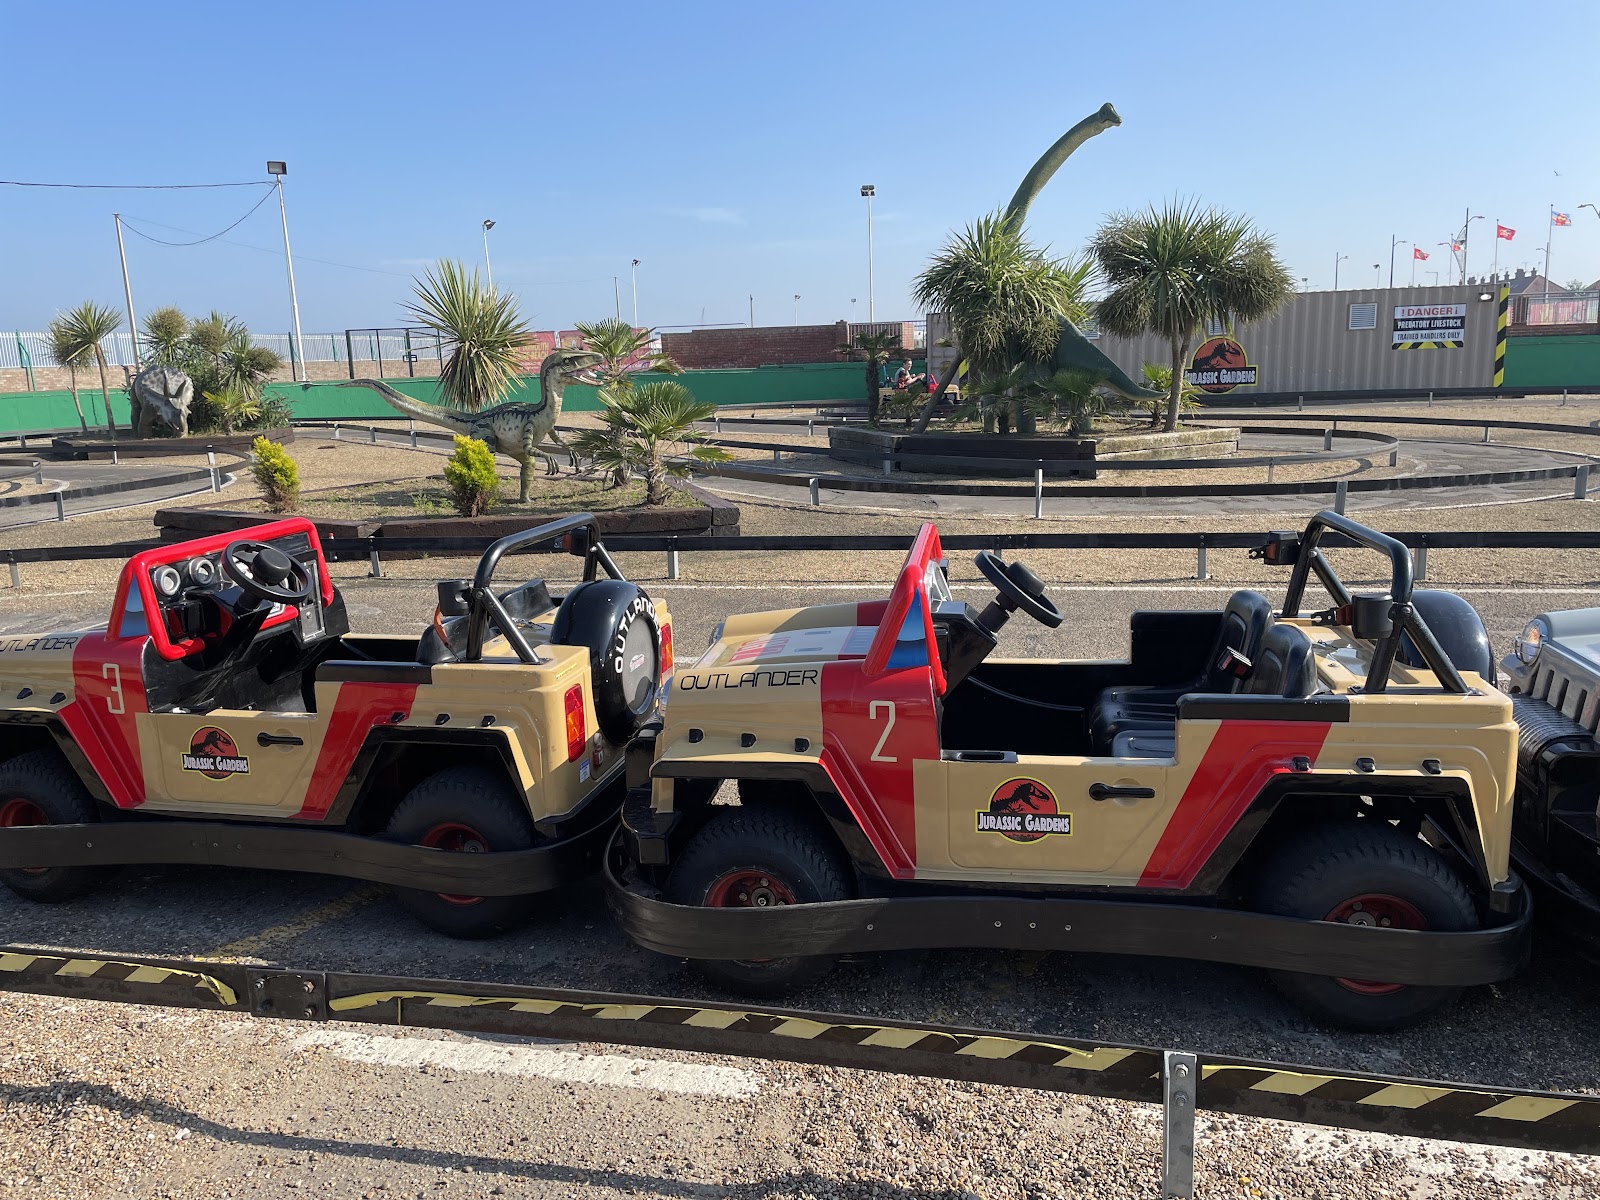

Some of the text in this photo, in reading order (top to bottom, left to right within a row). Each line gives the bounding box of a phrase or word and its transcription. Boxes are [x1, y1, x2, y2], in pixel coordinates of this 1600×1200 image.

[1407, 307, 1453, 316] DANGER
[1397, 319, 1461, 328] PREDATORY LIVESTOCK
[1220, 369, 1255, 383] GARDENS
[615, 596, 663, 673] OUTLANDER
[0, 637, 78, 652] UTLANDER
[103, 663, 125, 714] 3
[680, 669, 819, 690] OUTLANDER
[869, 700, 898, 762] 2
[184, 755, 248, 772] JURASSIC GARDENS
[979, 813, 1070, 832] JURASSIC GARDENS
